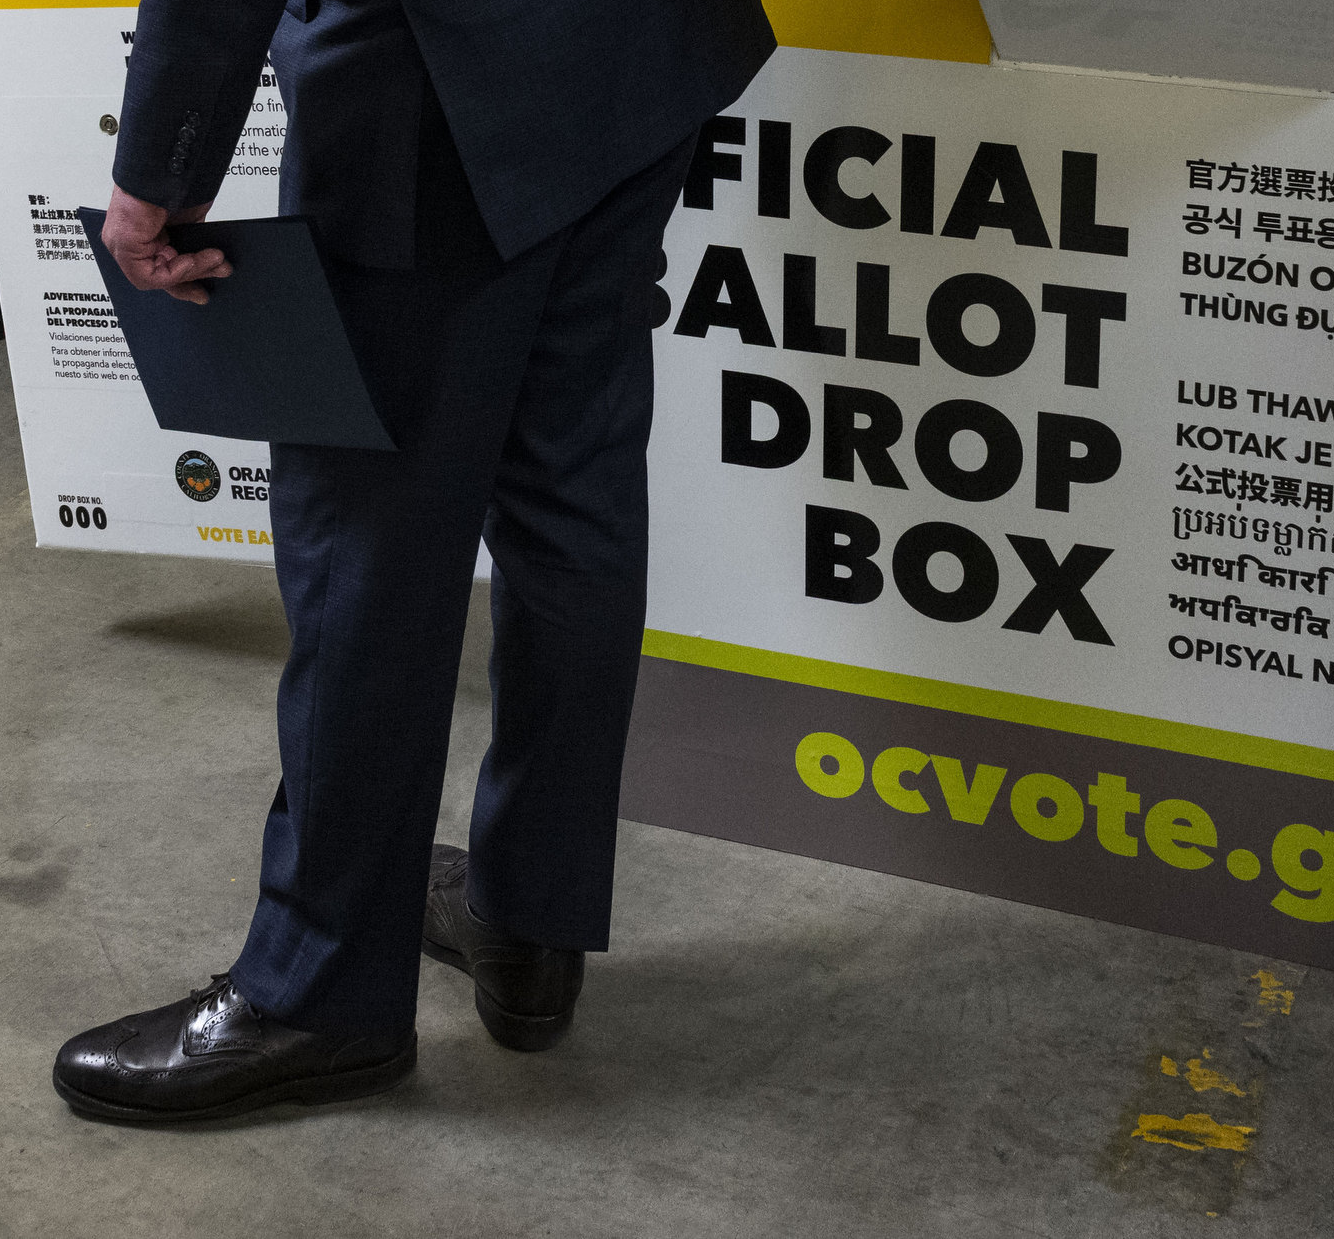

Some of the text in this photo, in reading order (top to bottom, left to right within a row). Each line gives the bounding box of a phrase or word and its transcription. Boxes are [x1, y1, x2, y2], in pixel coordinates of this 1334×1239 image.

[248, 142, 269, 156] the
[1182, 204, 1242, 239] 공식
[1181, 251, 1299, 288] BUZÓN
[43, 292, 110, 302] ADVERTENCIA:
[1179, 291, 1289, 328] THÙNG
[47, 317, 109, 329] DEL PROCESO
[650, 244, 1127, 389] ALLOT
[49, 332, 93, 343] Violaciones
[52, 347, 101, 358] Para obtener
[53, 358, 60, 367] la
[62, 360, 109, 371] propaganda
[83, 370, 99, 380] sitio
[101, 371, 117, 380] web
[1177, 379, 1238, 411] LUB
[721, 369, 1123, 513] DROP
[1175, 422, 1288, 461] KOTAK
[58, 494, 103, 505] DROP BOX NO.
[59, 504, 108, 530] 000
[197, 526, 244, 544] VOTE
[805, 503, 1117, 648] BOX
[1168, 634, 1304, 680] OPISYAL
